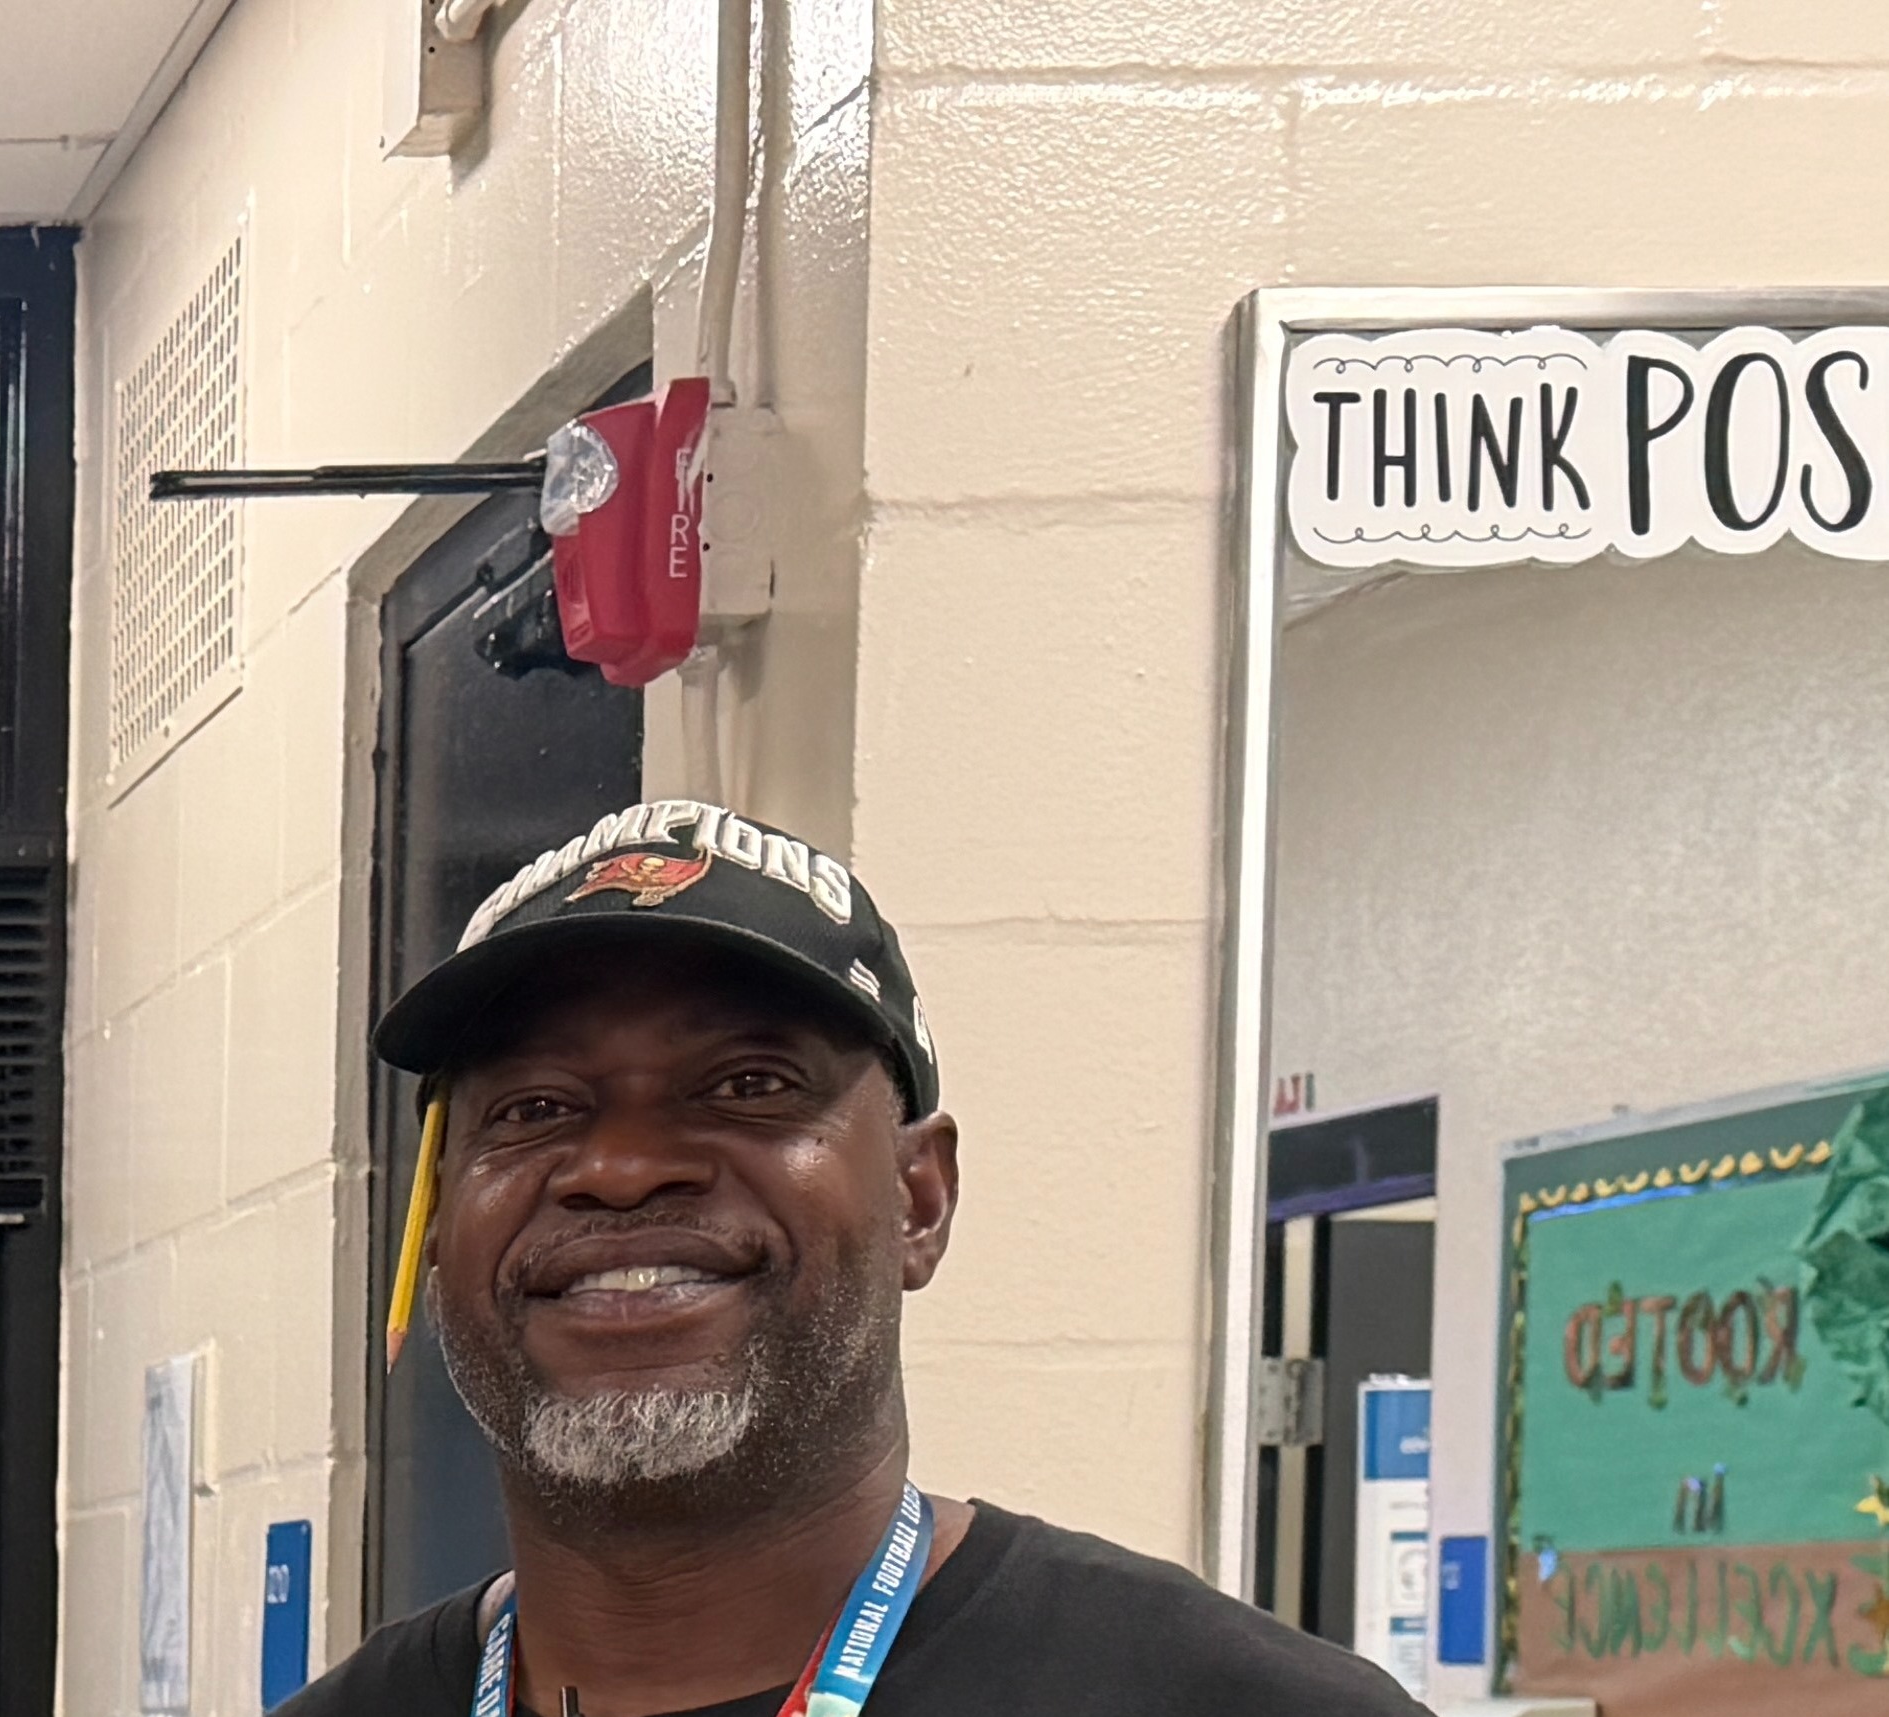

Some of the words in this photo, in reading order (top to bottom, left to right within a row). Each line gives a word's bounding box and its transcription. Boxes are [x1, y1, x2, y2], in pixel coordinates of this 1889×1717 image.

[1313, 383, 1591, 512] THINK
[1627, 350, 1874, 536] POS
[833, 1601, 889, 1682] NATIONAL
[872, 1521, 918, 1597] FOOTBALL
